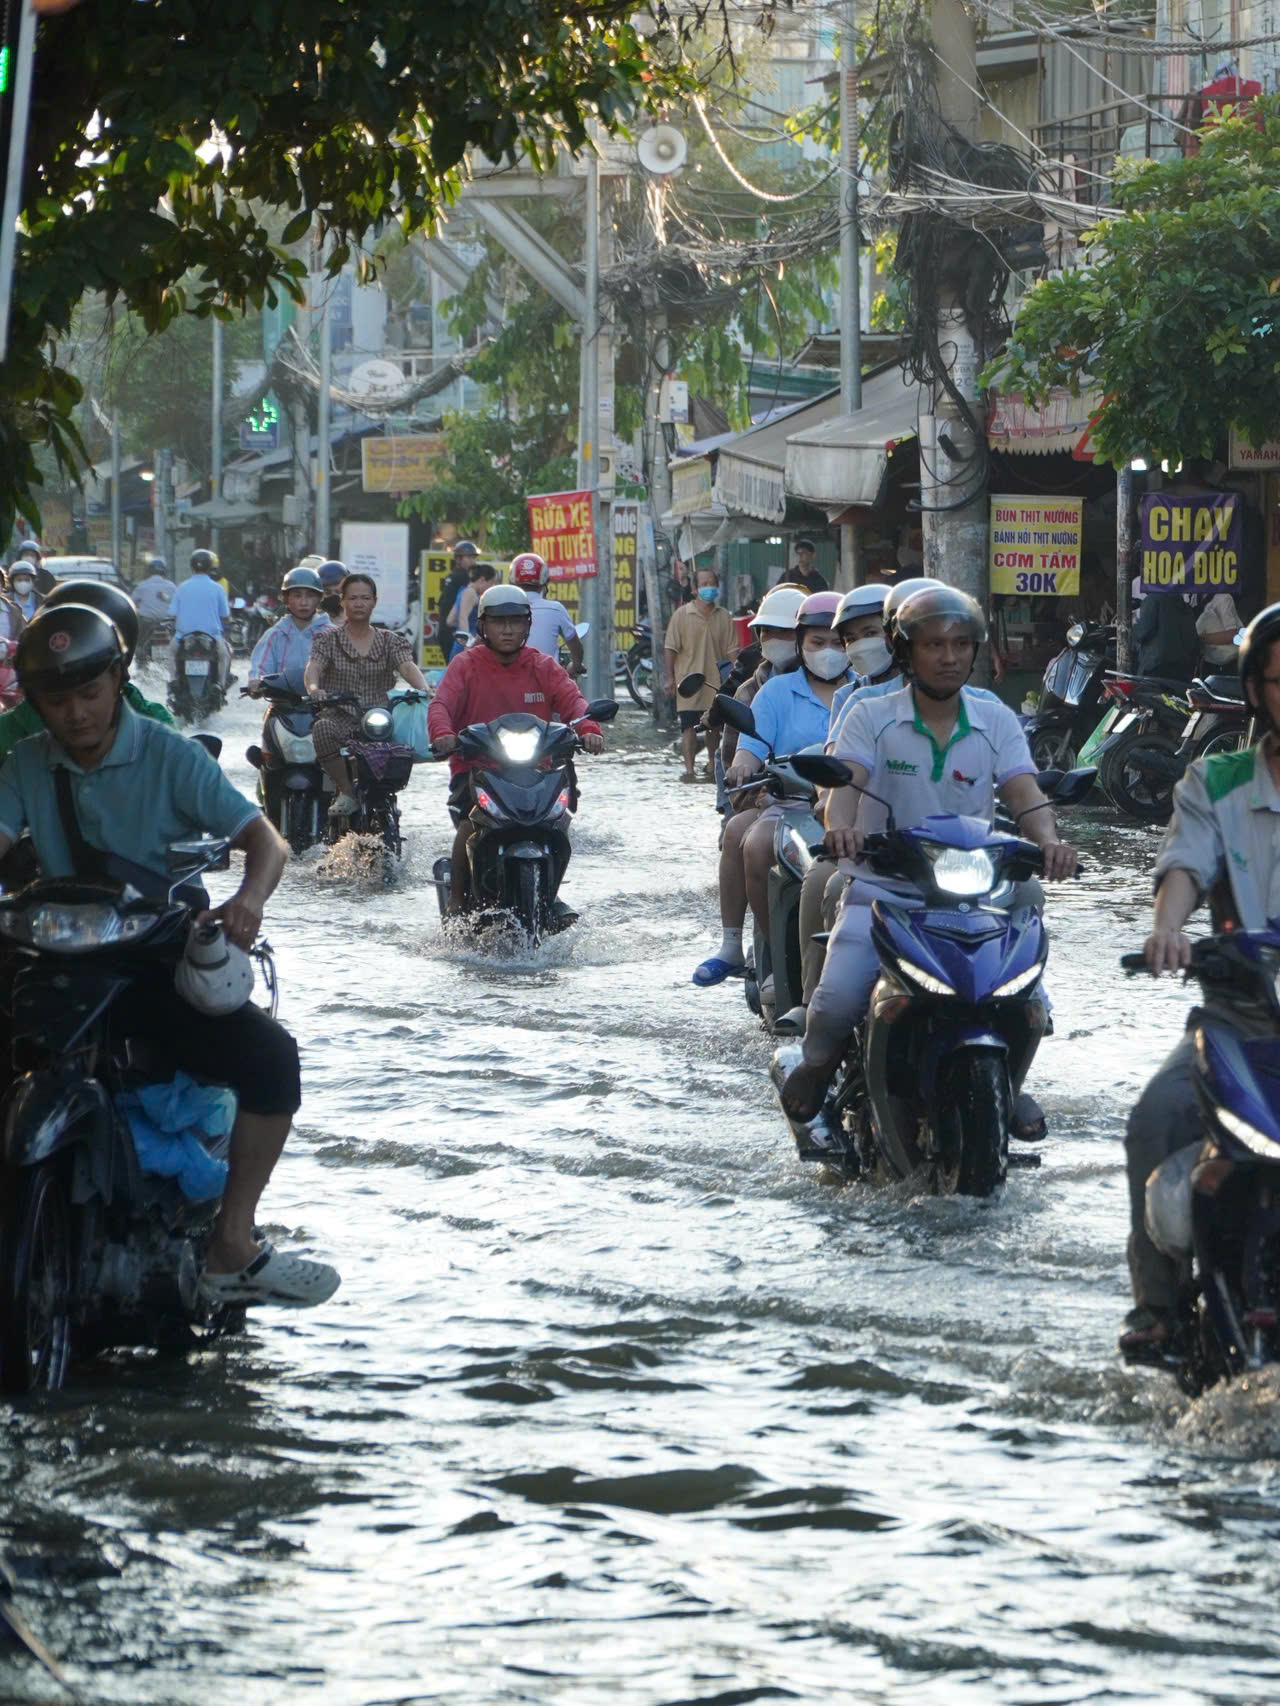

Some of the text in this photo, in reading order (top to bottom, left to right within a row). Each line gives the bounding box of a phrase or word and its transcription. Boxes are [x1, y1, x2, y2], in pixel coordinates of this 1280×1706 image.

[569, 501, 590, 528] XE
[1020, 510, 1040, 526] THỊT
[1149, 506, 1233, 542] CHAY
[994, 552, 1033, 568] CƠM
[1144, 544, 1237, 584] HOA ĐỨC
[1016, 572, 1056, 593] 30K
